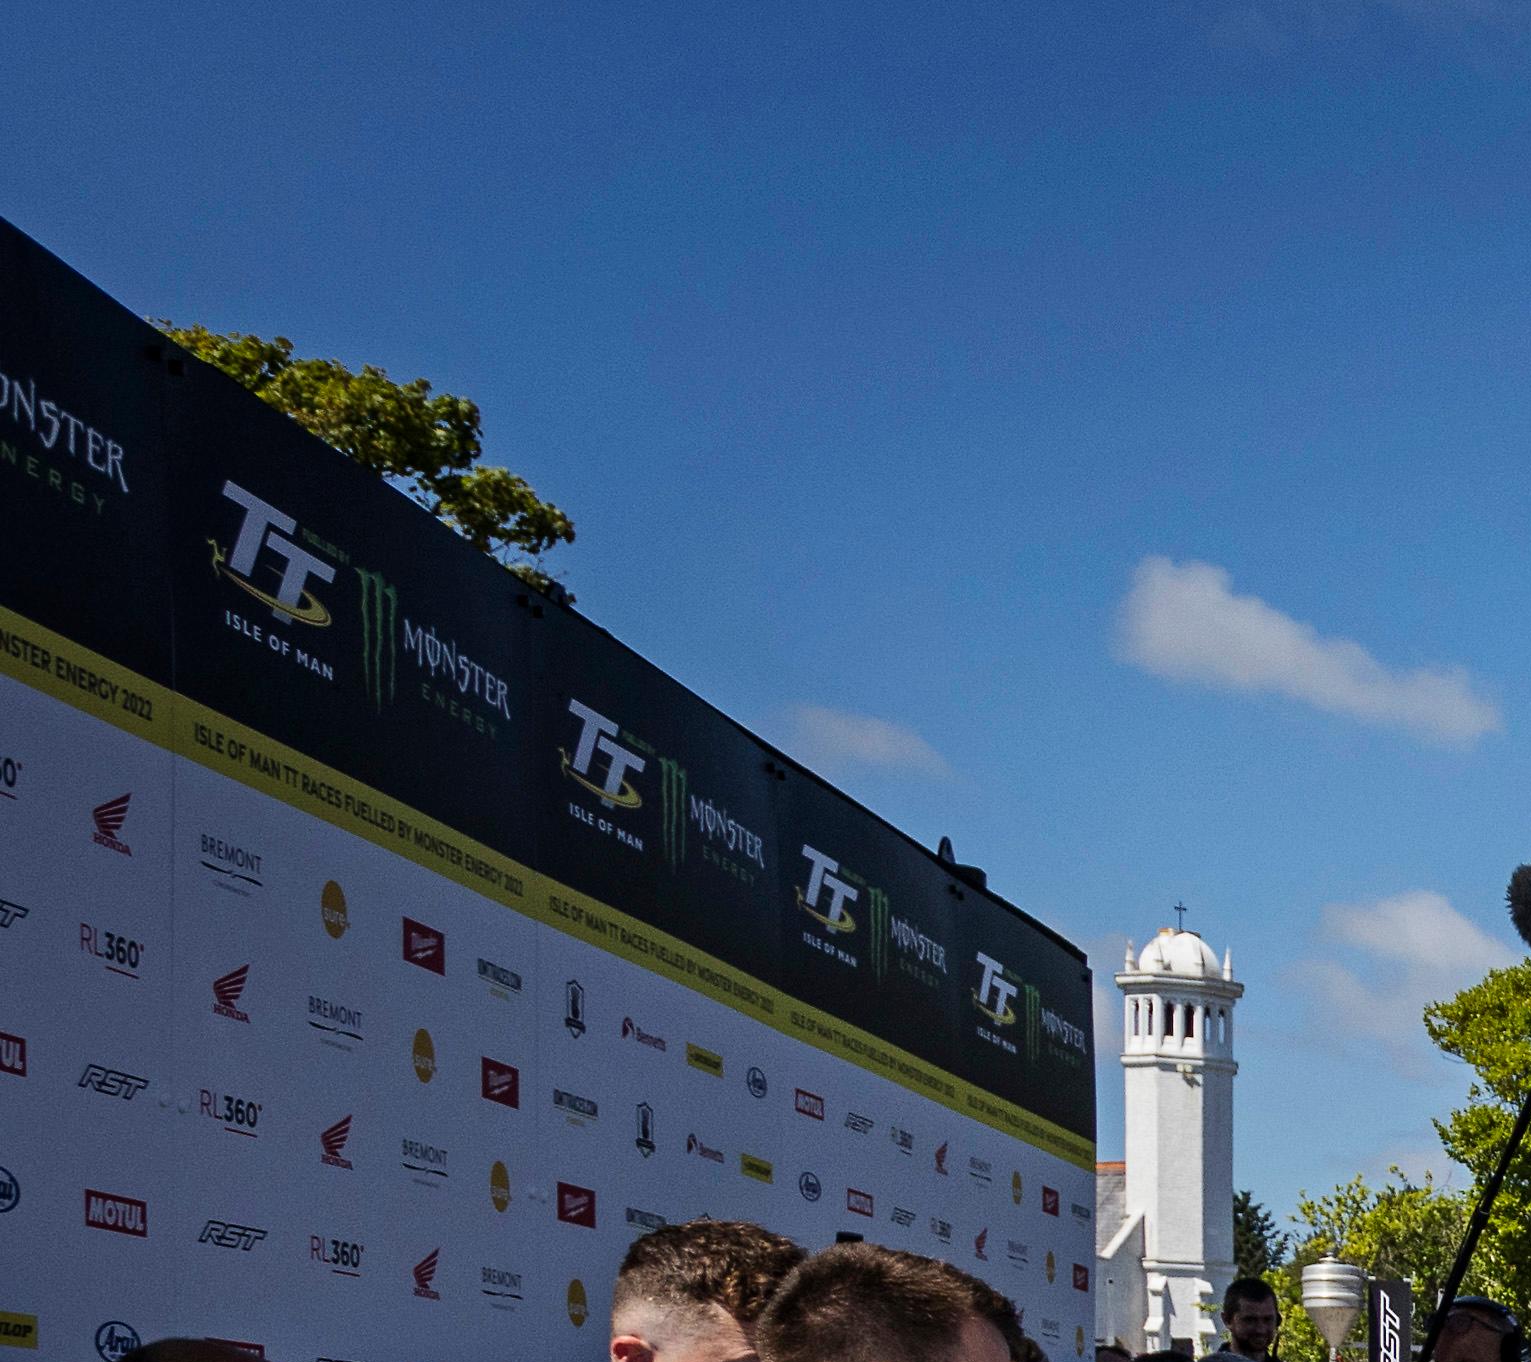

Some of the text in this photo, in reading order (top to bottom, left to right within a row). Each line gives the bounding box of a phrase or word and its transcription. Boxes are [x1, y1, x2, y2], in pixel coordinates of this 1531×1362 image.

[222, 479, 337, 626] TT
[224, 609, 335, 682] ISLE OF MAN
[404, 617, 511, 720] MONSTER
[569, 698, 646, 810] TT
[194, 722, 224, 754] ISLE
[228, 740, 247, 760] OF
[250, 744, 281, 782] MAN
[283, 764, 299, 788] TT
[301, 774, 344, 810] RACES
[345, 793, 396, 834] FUELLED
[399, 820, 412, 841] BY
[414, 827, 464, 866] MONSTER
[465, 853, 501, 886] ENERGY
[94, 832, 132, 857] HONDA
[569, 802, 645, 852] ISLE OF MAN
[201, 833, 262, 875] BREMONT
[802, 844, 858, 936] TT
[213, 1003, 250, 1024] HONDA
[307, 995, 364, 1029] BREMONT
[78, 1063, 150, 1100] RST
[402, 1138, 449, 1167] BREMONT
[88, 1195, 145, 1232] MOTUL
[198, 1219, 268, 1251] RST
